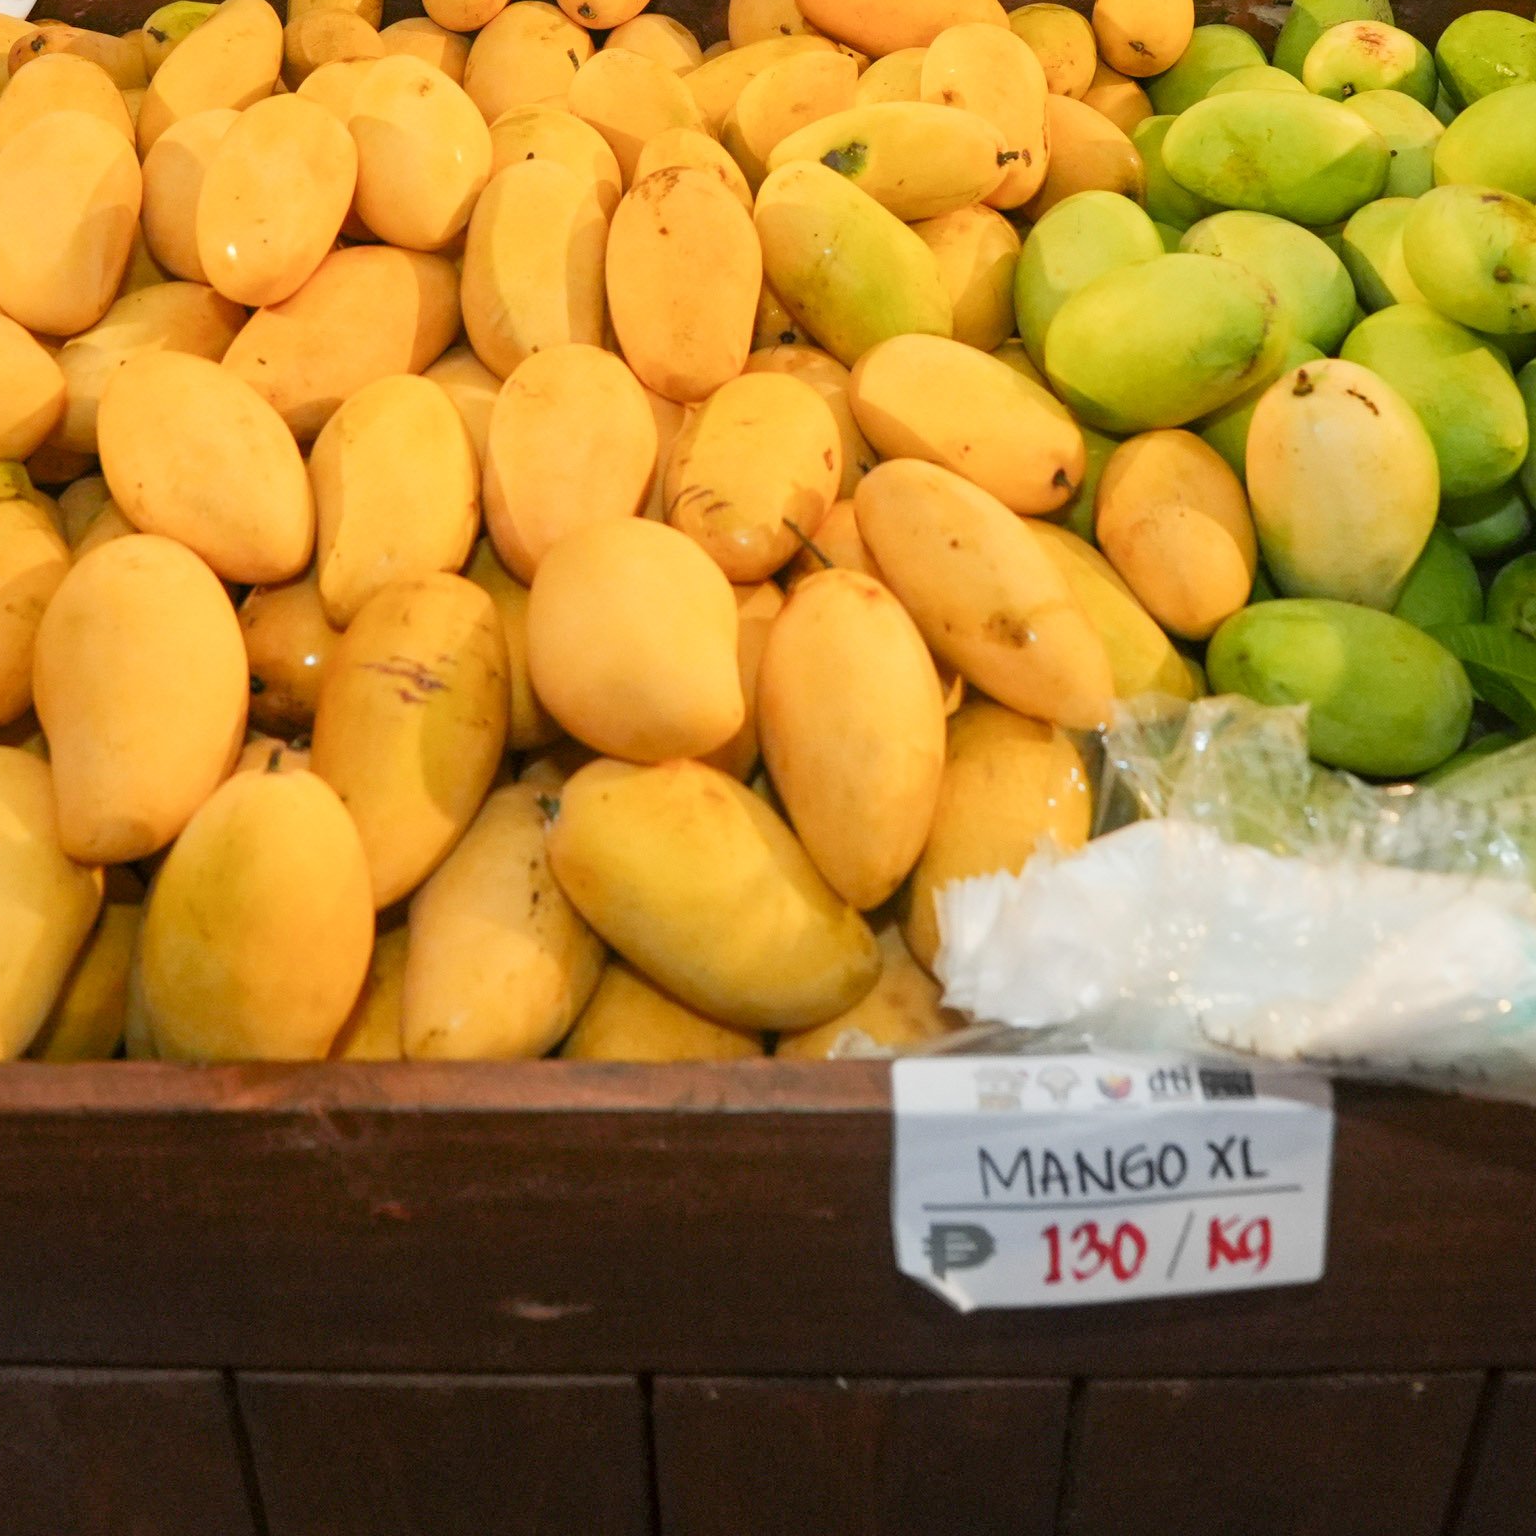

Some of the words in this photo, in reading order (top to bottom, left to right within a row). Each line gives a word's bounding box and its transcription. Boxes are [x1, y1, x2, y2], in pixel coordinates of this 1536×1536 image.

[978, 1144, 1188, 1197] MANGO
[1206, 1135, 1269, 1181] XL
[1041, 1221, 1147, 1285] 130
